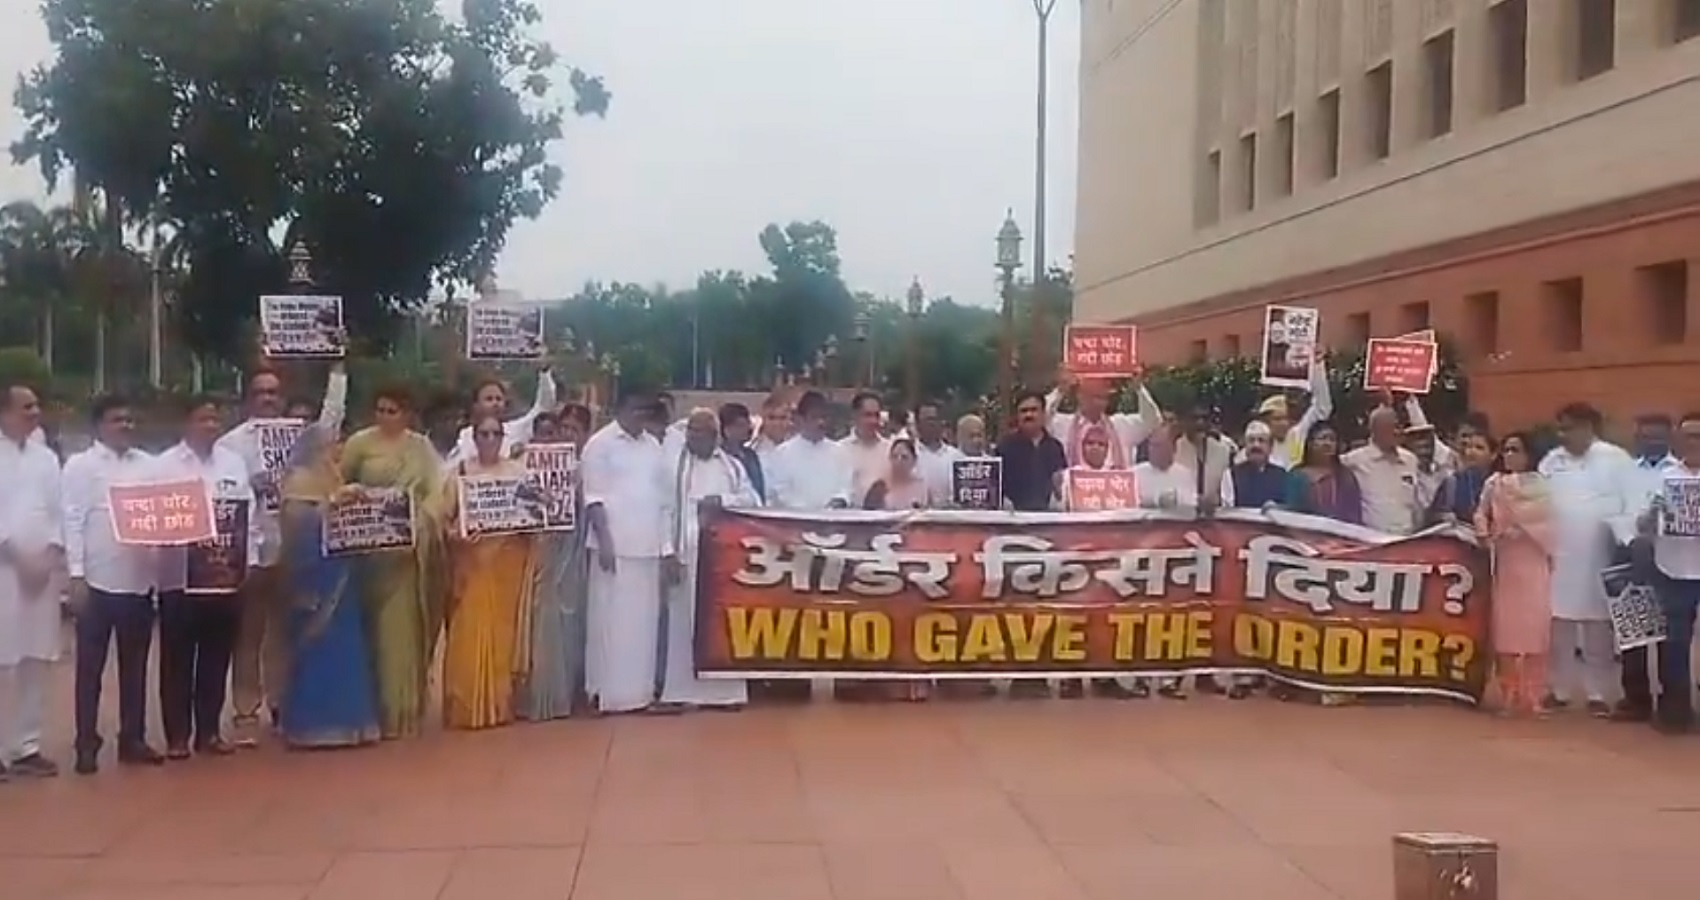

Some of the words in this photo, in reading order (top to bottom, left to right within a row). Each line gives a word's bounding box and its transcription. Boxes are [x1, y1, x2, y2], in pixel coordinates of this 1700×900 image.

[526, 452, 569, 469] AMIT
[732, 532, 958, 597] ऑर्डर
[974, 533, 1222, 599] किसने
[1238, 535, 1475, 616] दिया?
[727, 607, 892, 662] WHO
[914, 611, 1089, 663] GAVE
[1108, 612, 1213, 661] THE
[1234, 611, 1475, 682] ORDER?
